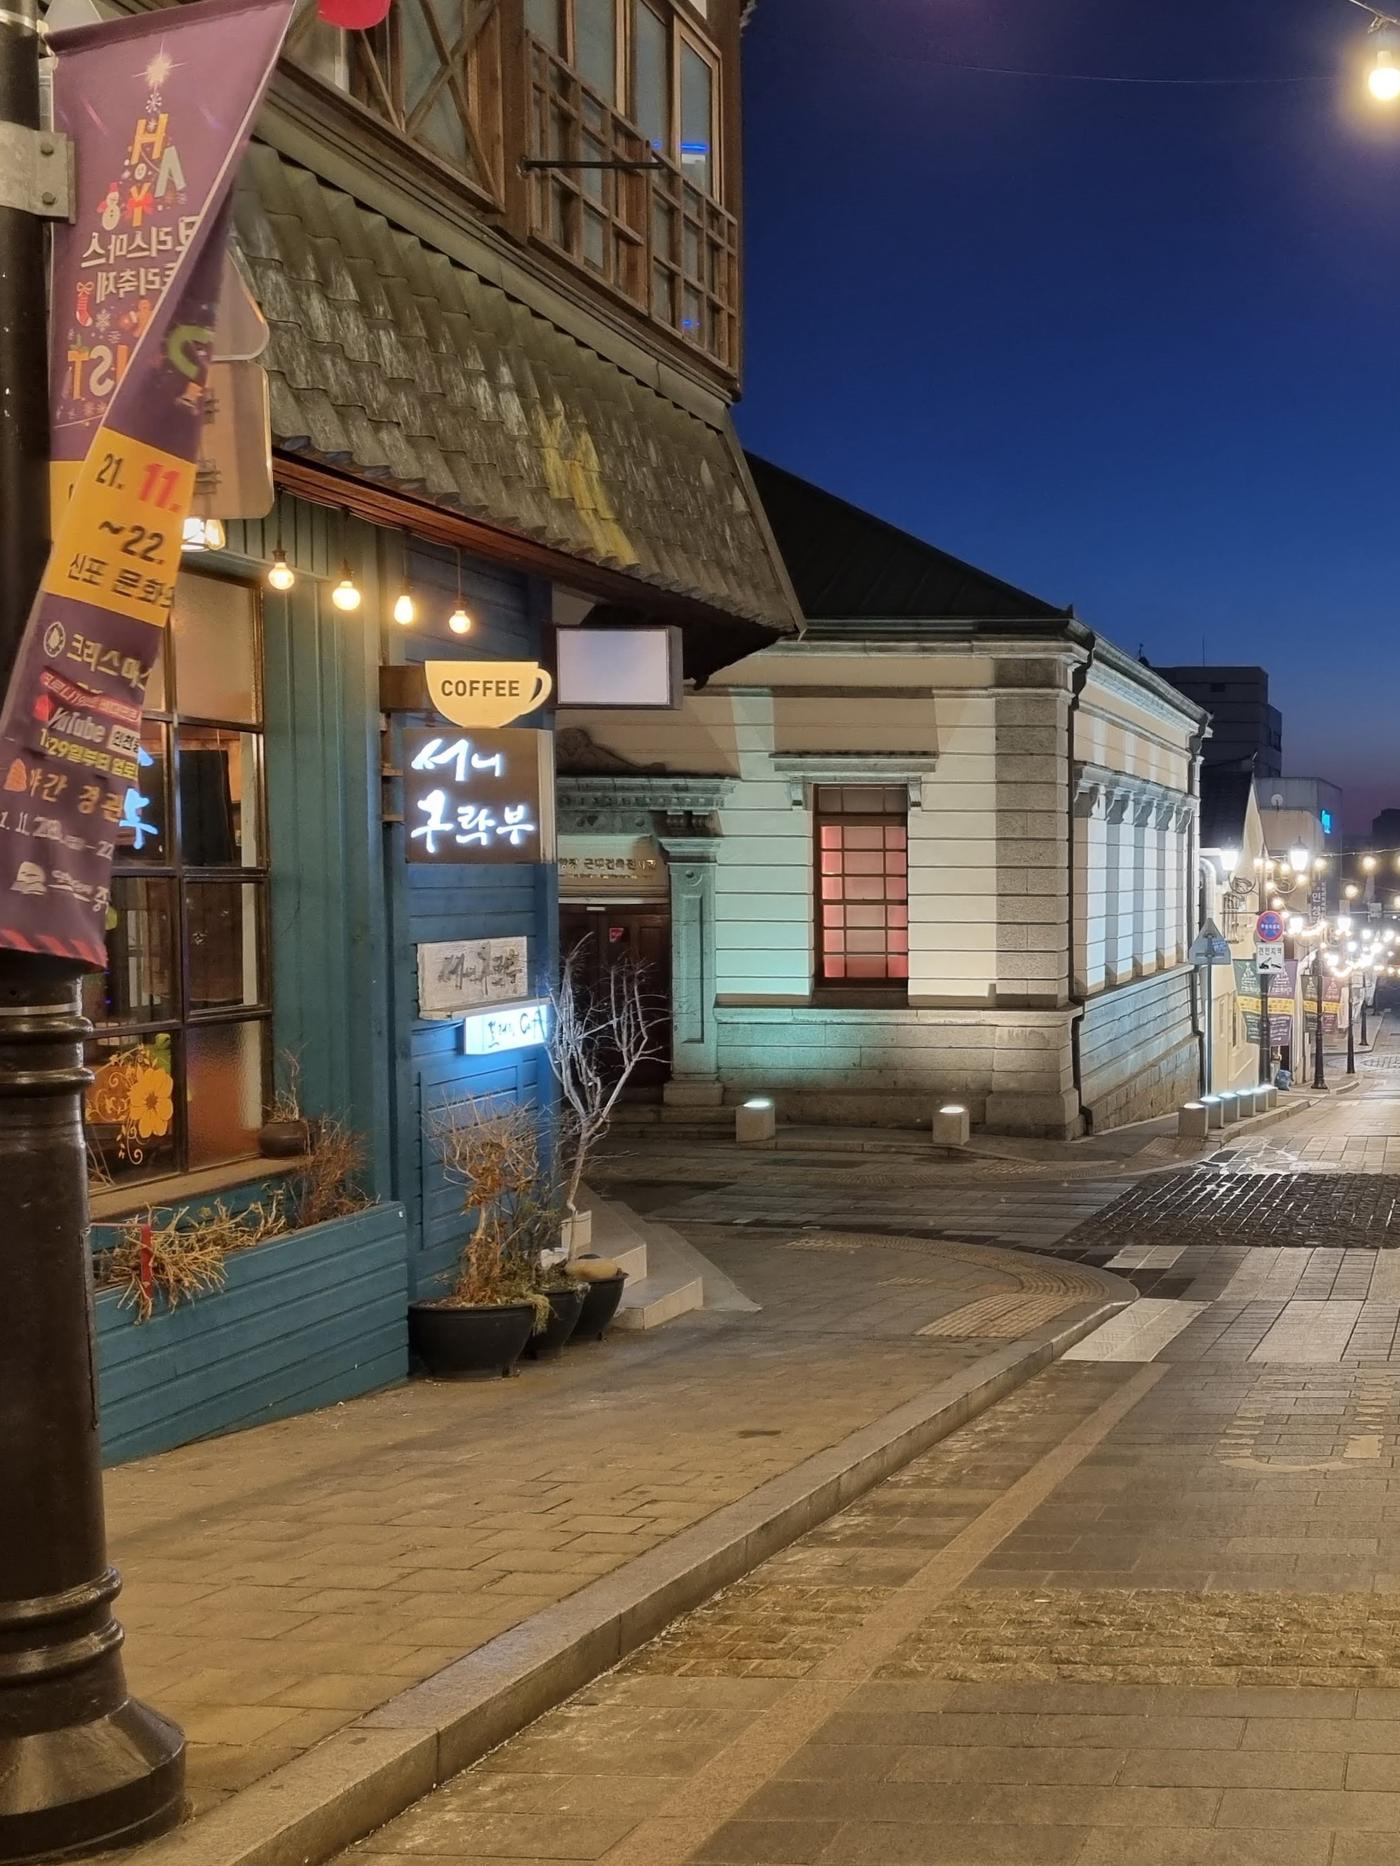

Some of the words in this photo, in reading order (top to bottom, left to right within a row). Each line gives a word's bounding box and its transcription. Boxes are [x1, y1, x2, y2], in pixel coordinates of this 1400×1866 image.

[138, 463, 182, 513] 11.
[69, 552, 109, 587] 신포
[441, 679, 520, 697] COFFEE
[410, 789, 536, 853] 구락부
